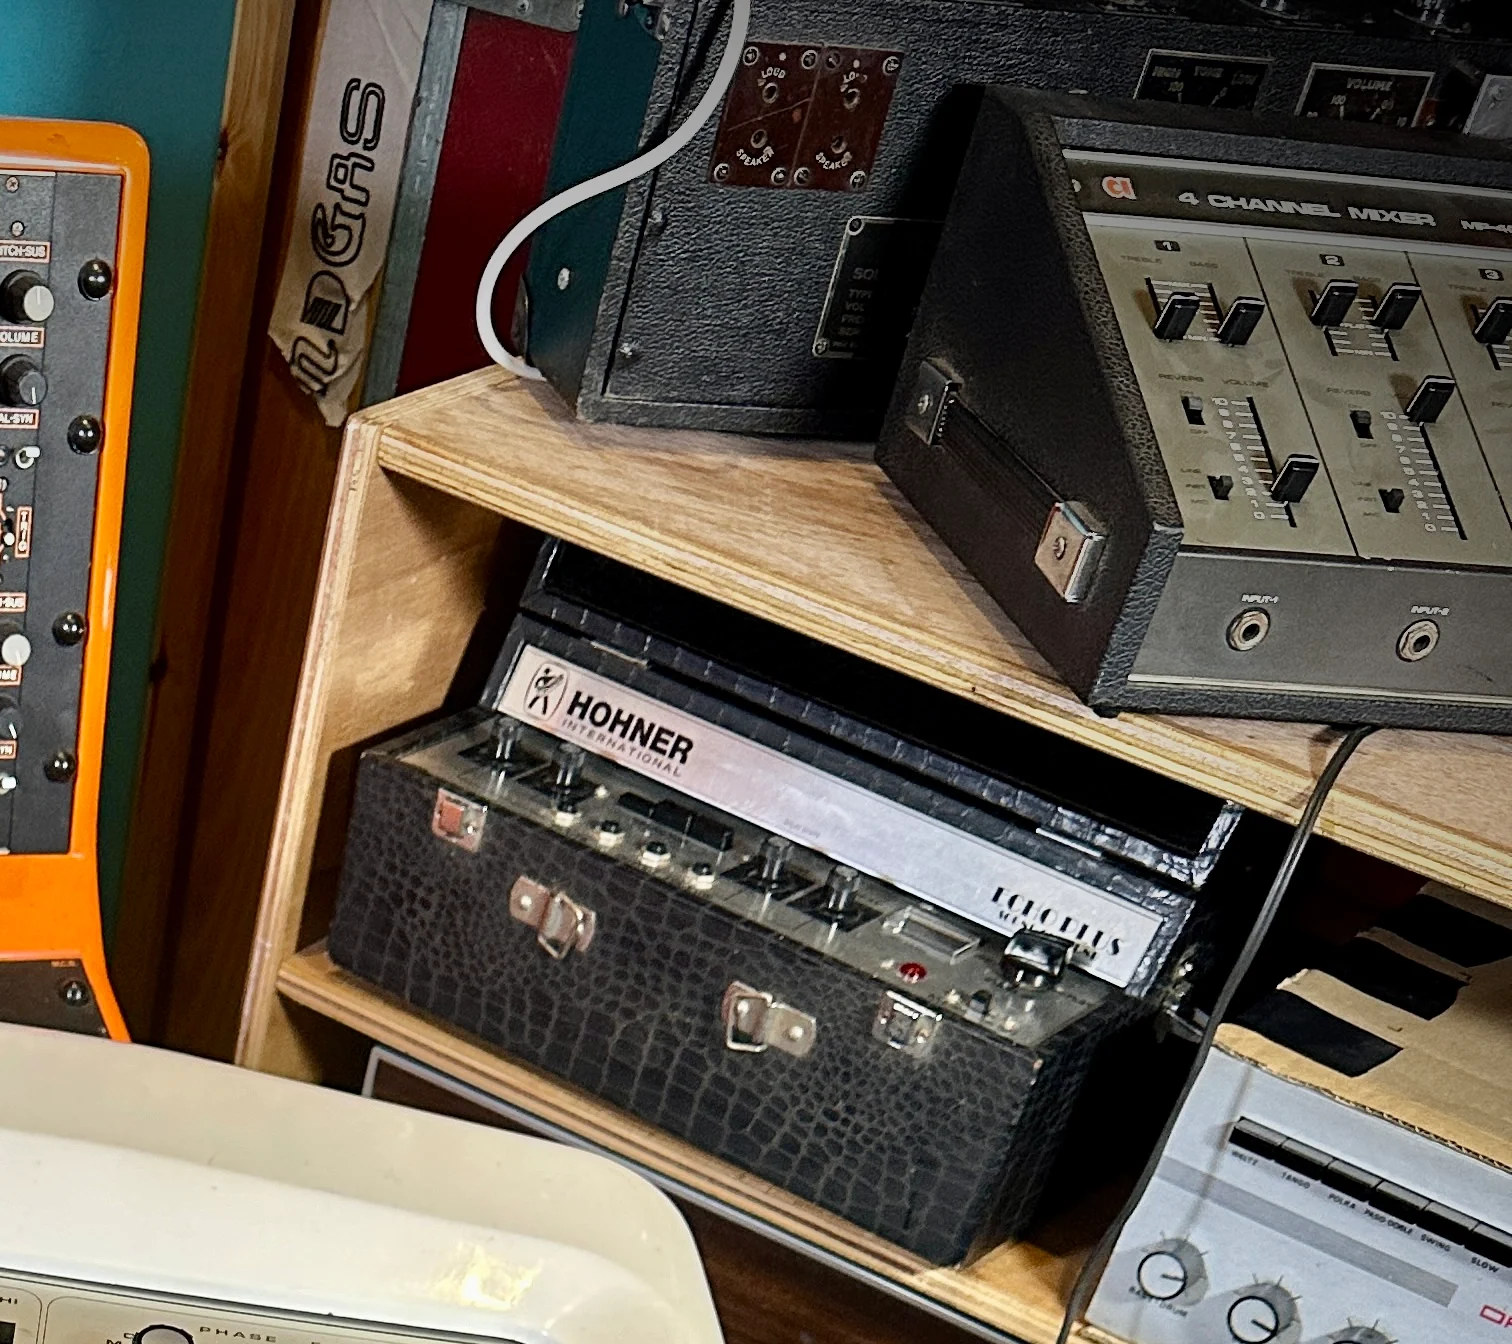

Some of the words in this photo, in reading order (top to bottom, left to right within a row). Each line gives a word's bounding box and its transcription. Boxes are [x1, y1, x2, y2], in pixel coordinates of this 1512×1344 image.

[1178, 192, 1199, 205] 4
[1207, 194, 1342, 218] CHANNEL
[1347, 207, 1437, 227] MIXER
[1158, 373, 1204, 383] REVERB
[1222, 379, 1269, 388] VOLUME
[566, 689, 694, 765] HOHNER
[561, 718, 683, 779] INTERNATIONAL
[1281, 1171, 1311, 1190] TANGO
[1328, 1193, 1356, 1210] POLKA
[1420, 1233, 1451, 1252] SWING
[1471, 1256, 1499, 1274] SLOW
[199, 1325, 277, 1344] PHASE
